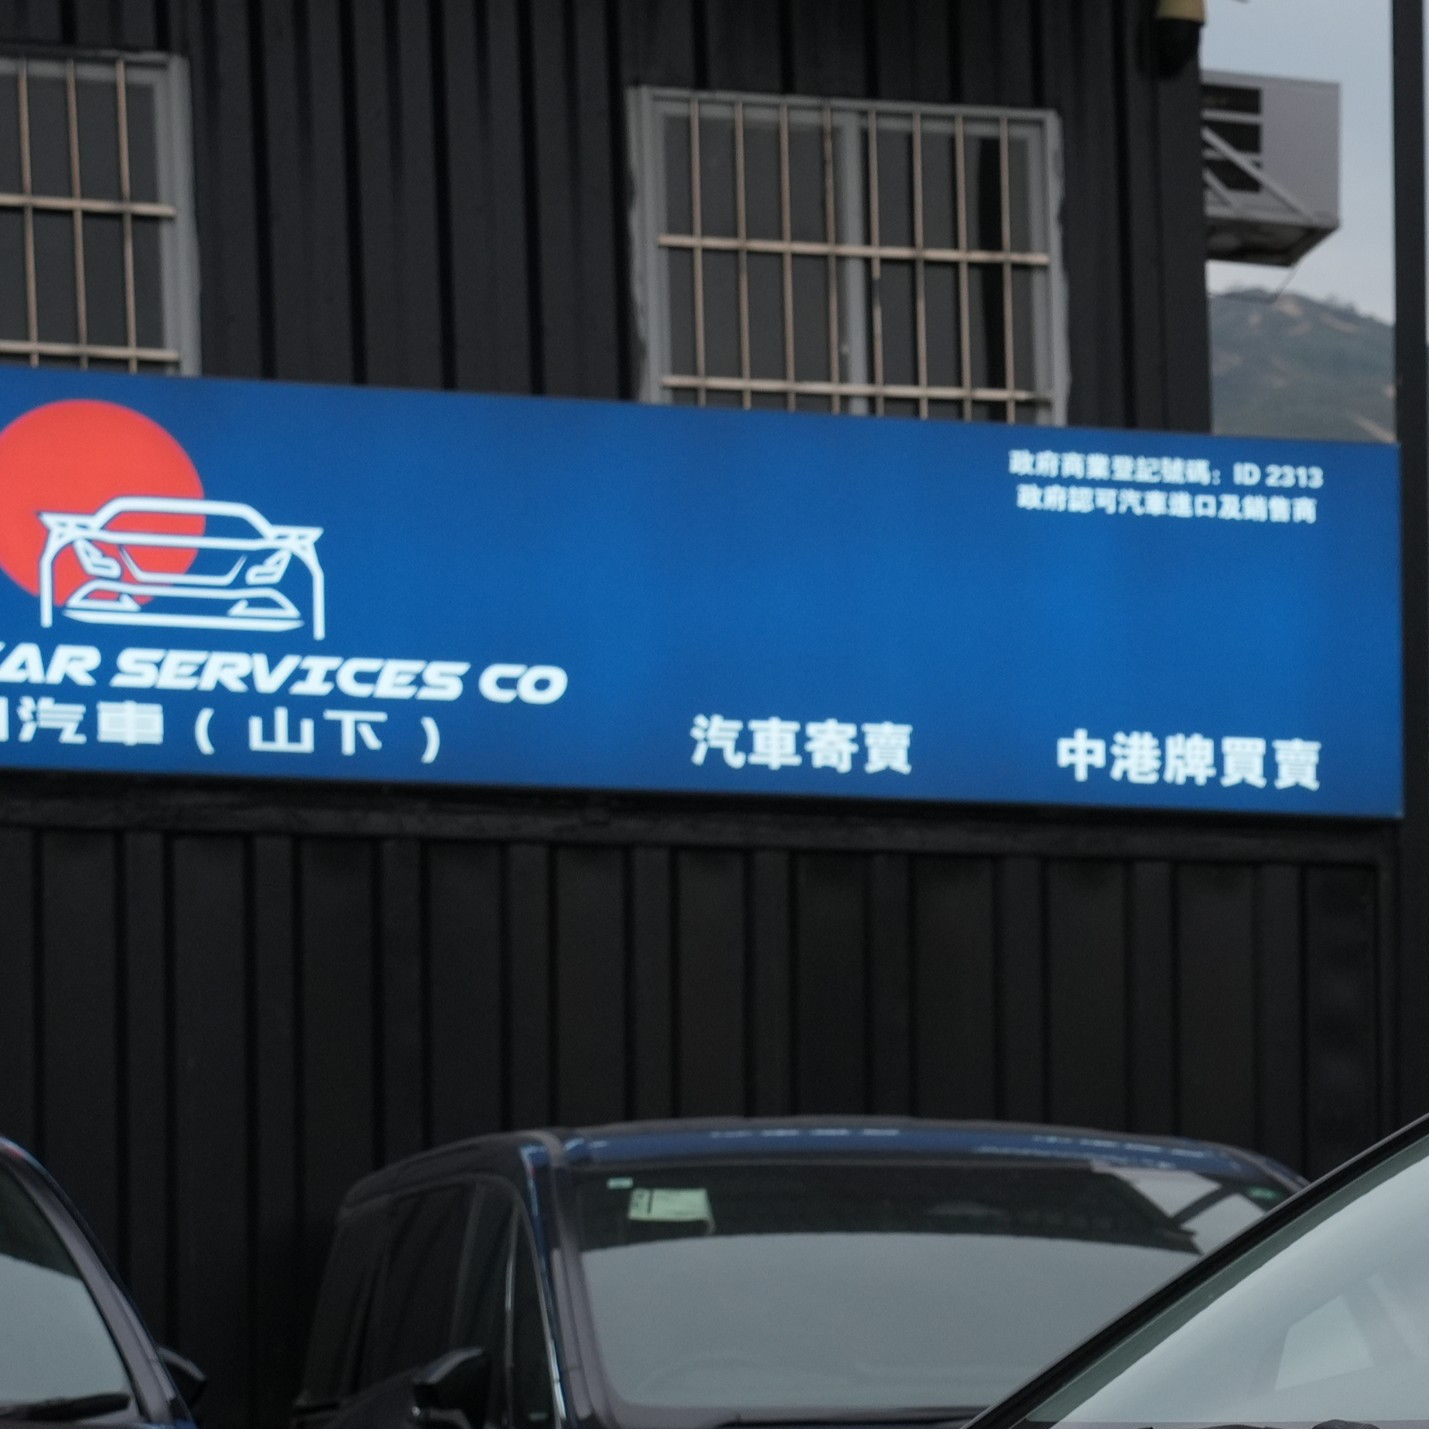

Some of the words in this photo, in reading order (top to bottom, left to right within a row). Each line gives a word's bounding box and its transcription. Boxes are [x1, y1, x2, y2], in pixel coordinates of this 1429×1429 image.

[1232, 462, 1262, 487] ID
[1265, 464, 1324, 489] 2313
[0, 641, 101, 687] AR
[110, 647, 470, 701] SERVICES
[478, 663, 568, 705] CO
[690, 714, 913, 775] 汽車寄賣
[1056, 728, 1321, 791] 中港牌買賣
